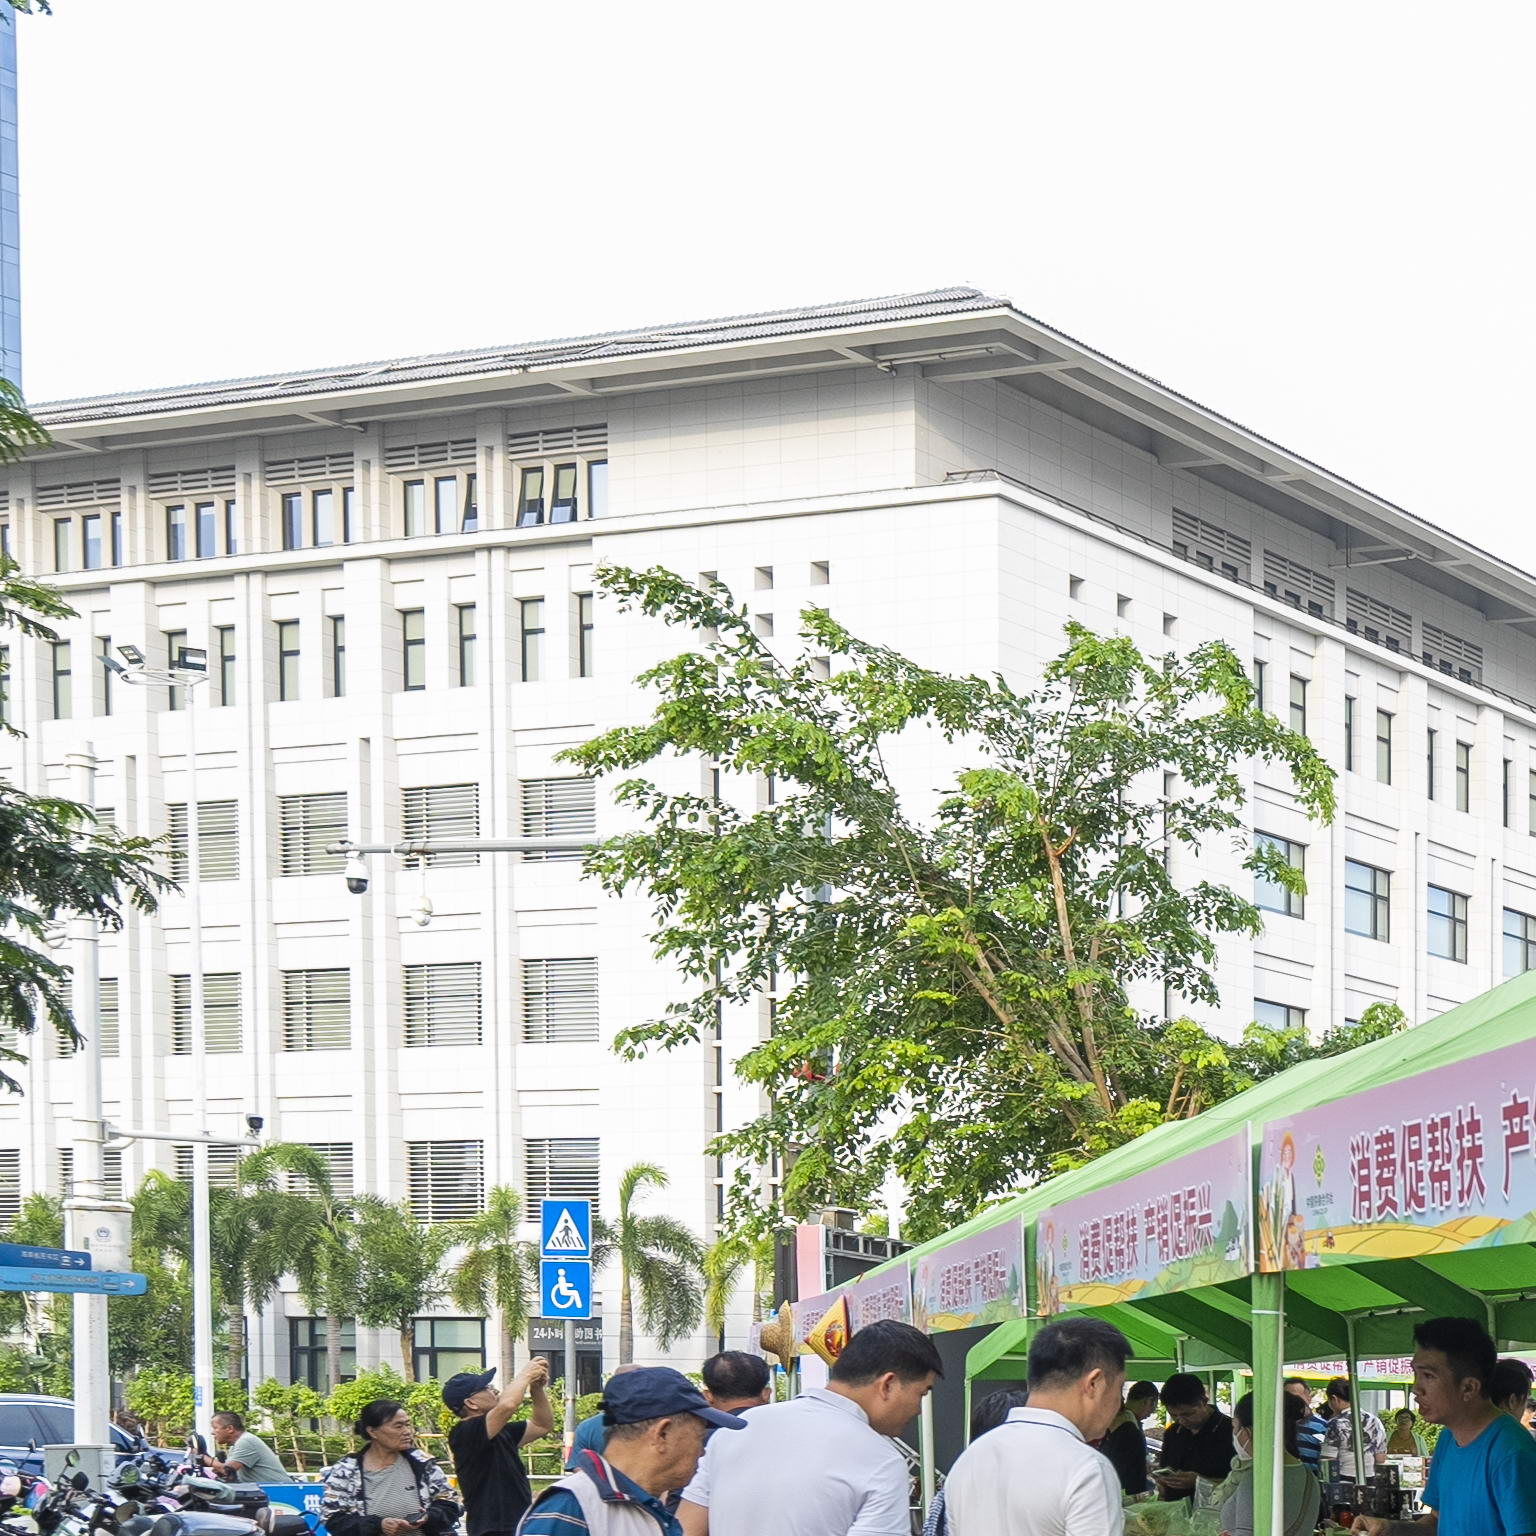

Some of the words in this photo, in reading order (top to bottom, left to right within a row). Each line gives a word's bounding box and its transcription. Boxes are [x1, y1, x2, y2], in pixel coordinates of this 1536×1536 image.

[1350, 1102, 1486, 1224] 消费促帮扶
